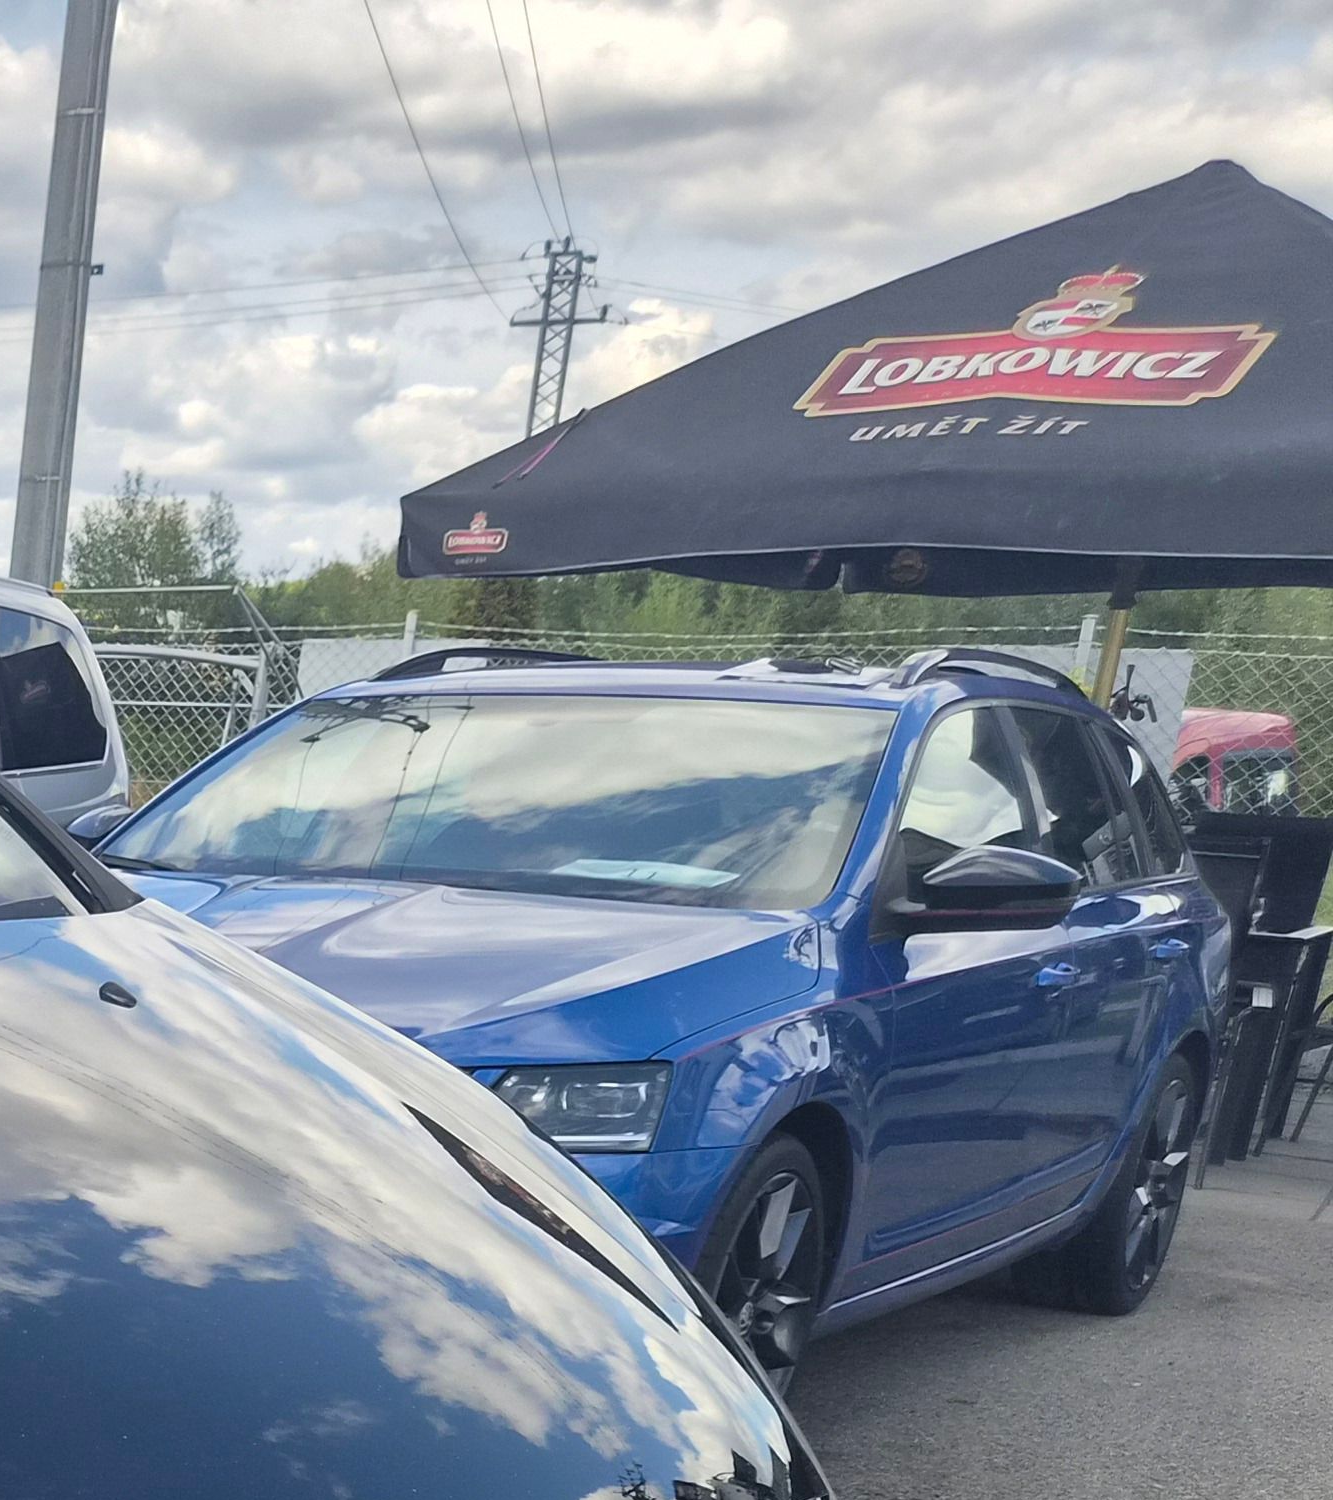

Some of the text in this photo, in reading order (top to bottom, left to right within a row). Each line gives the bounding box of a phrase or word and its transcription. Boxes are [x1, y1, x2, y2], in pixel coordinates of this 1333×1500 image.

[837, 347, 1227, 396] LOBKOWICZ
[849, 414, 1090, 442] UMĚT ŽÍT
